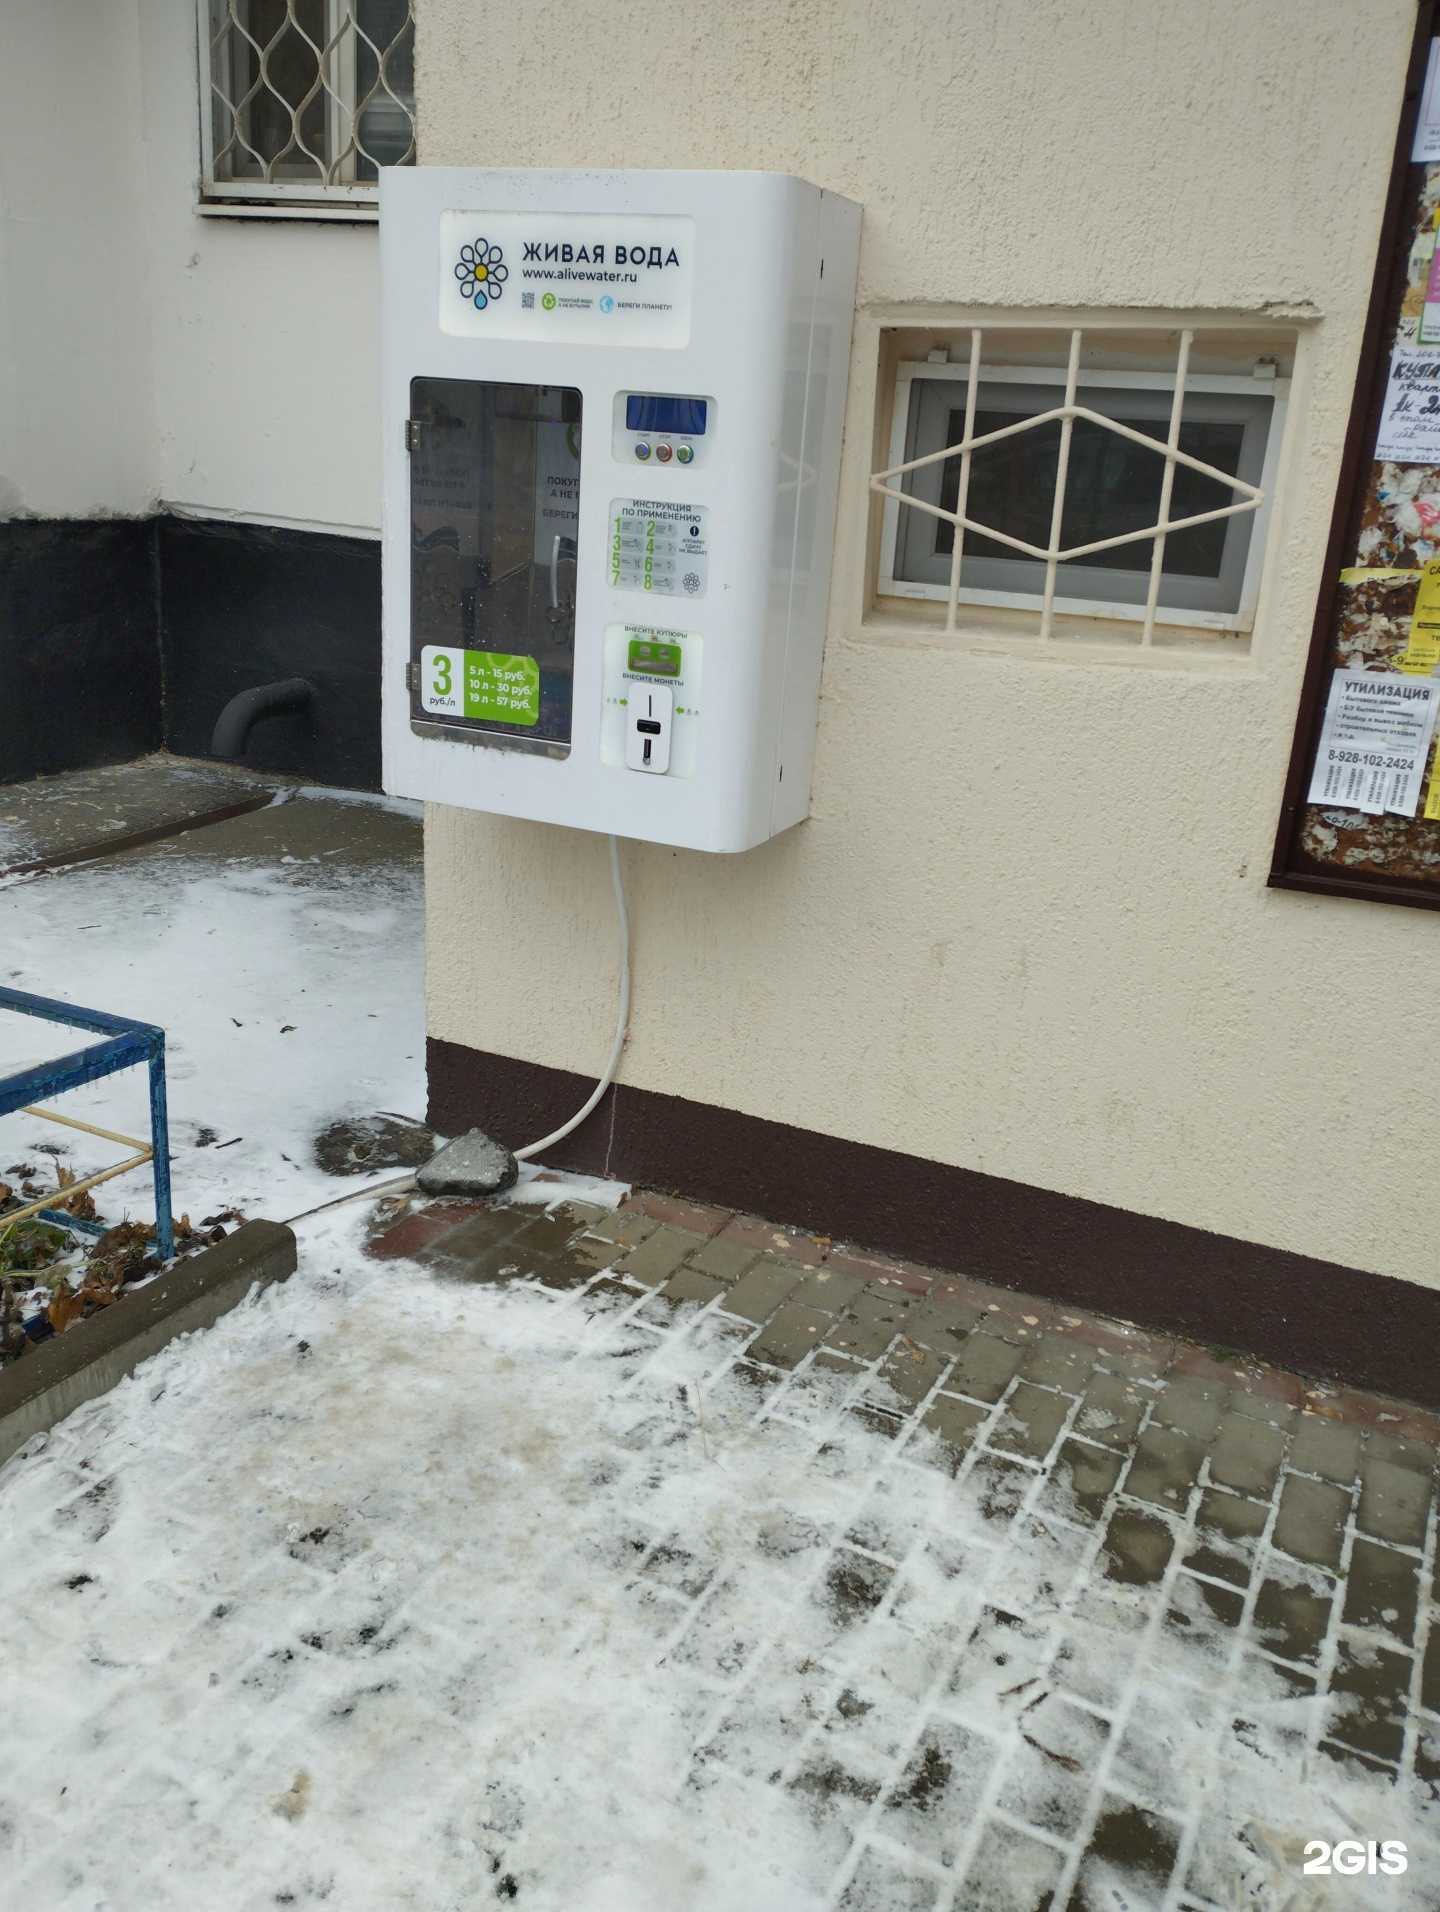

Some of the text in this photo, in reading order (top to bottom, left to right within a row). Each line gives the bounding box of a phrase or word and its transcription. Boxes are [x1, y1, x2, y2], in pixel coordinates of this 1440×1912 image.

[522, 242, 680, 269] ЖИВАЯ ВОДА
[522, 268, 638, 283] www.alivewater.ru
[632, 500, 691, 512] ИНСТРУКЦИЯ
[622, 508, 701, 522] ПО ПРИМЕНЕНИЮ
[614, 517, 621, 533] 1
[646, 521, 656, 537] 2
[613, 535, 621, 551] 3
[646, 539, 654, 554] 4
[612, 552, 621, 568] 5
[644, 557, 653, 572] 6
[612, 570, 620, 586] 7
[643, 574, 652, 590] 8
[624, 625, 688, 639] ВНЕСИТЕ КУПЮРЫ
[432, 654, 452, 696] 3
[469, 665, 476, 675] 5
[478, 667, 485, 676] л
[493, 667, 503, 678] 15
[504, 671, 527, 682] руб.
[622, 672, 684, 687] ВНЕСИТЕ МОНЕТЫ
[469, 680, 480, 689] 10
[482, 682, 489, 690] л
[496, 683, 509, 693] 30
[511, 686, 533, 697] руб.
[1345, 681, 1430, 701] УТИЛИЗАЦИЯ
[469, 693, 480, 704] 19
[482, 696, 489, 705] л
[496, 697, 508, 707] 57
[511, 700, 531, 711] руб.
[1328, 749, 1415, 771] 8-928-102-2424
